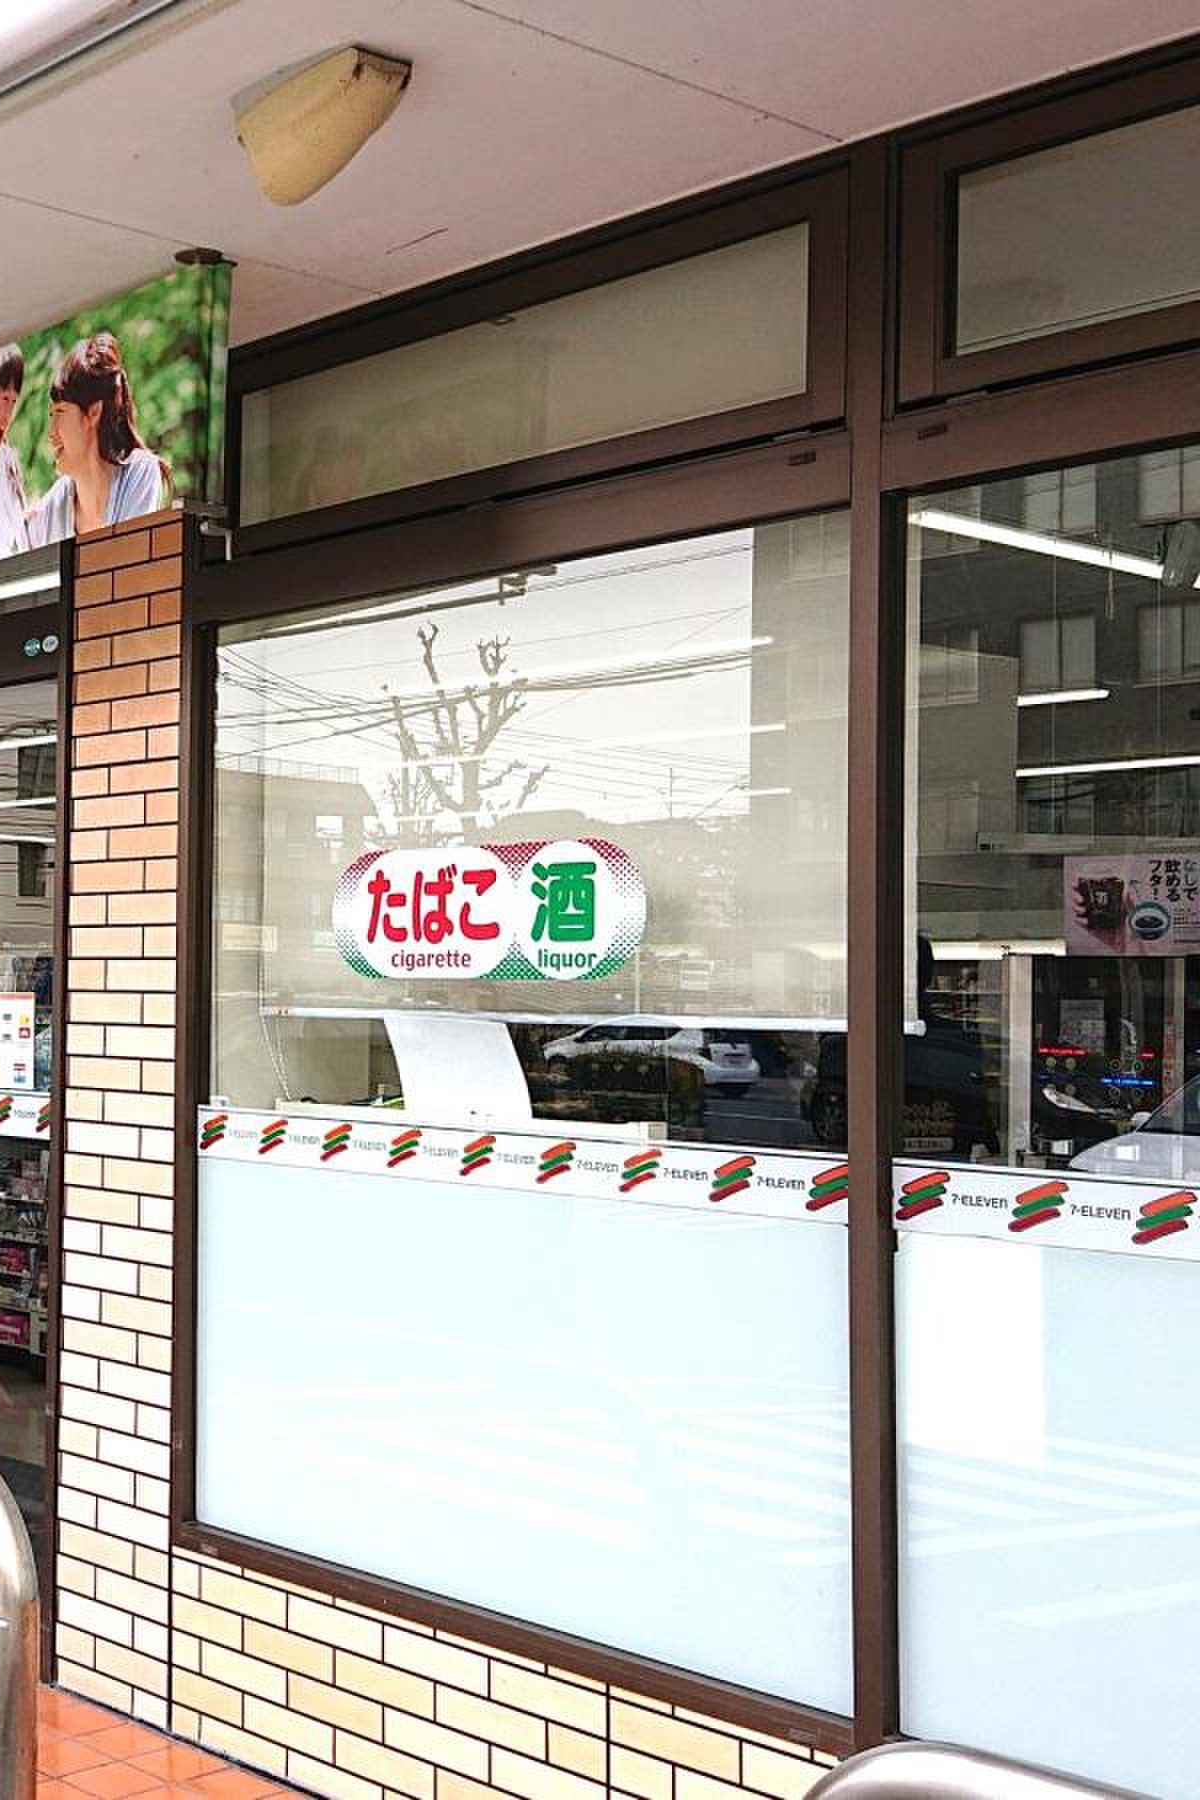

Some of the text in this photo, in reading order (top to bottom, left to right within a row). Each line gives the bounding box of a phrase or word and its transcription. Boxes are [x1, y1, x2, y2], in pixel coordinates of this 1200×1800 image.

[367, 863, 500, 944] たばこ
[530, 861, 597, 943] 酒
[390, 949, 472, 969] cigarette
[537, 949, 597, 969] liquor
